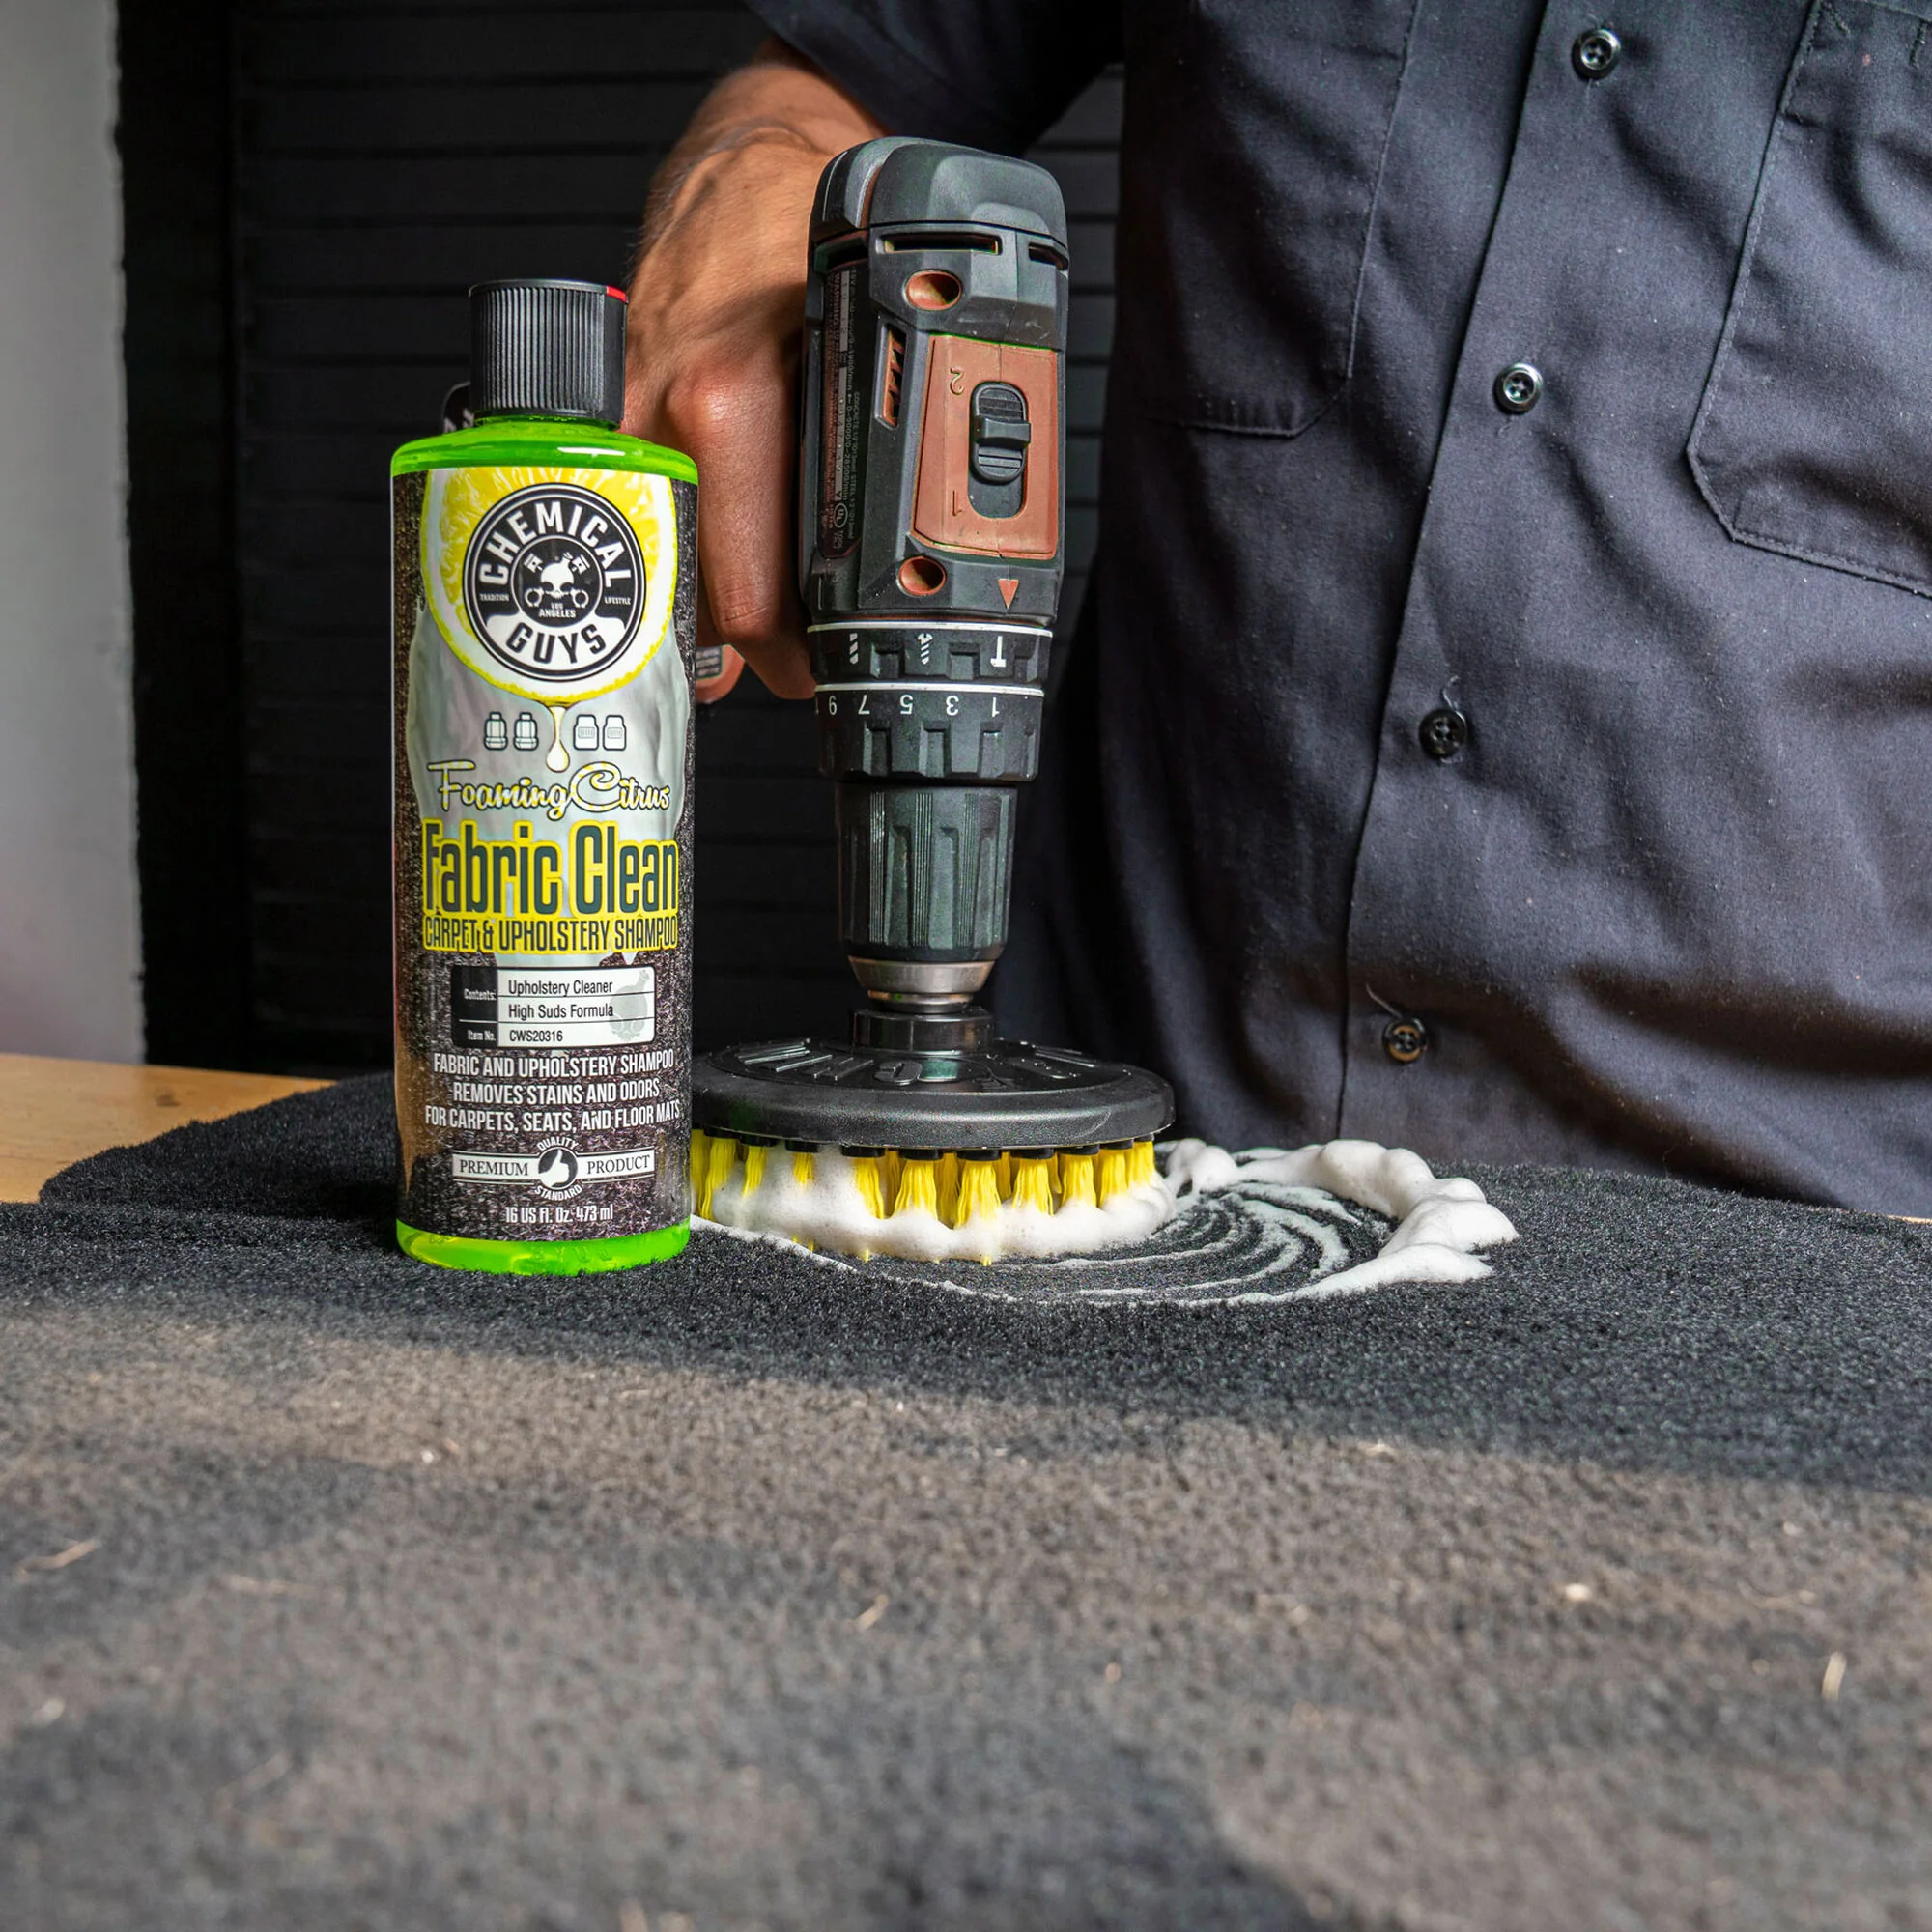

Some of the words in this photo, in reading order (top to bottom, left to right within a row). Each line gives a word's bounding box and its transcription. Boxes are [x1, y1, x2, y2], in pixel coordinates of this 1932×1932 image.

[950, 367, 964, 396] 2
[479, 501, 632, 588] CHEMICAL
[479, 593, 510, 603] TRADITION
[551, 602, 563, 611] LOS
[604, 595, 632, 606] LIFESTYLE
[538, 609, 577, 619] ANGELES
[506, 621, 606, 665] GUYS
[828, 695, 838, 715] 9
[857, 694, 870, 715] 7
[899, 694, 914, 715] 5
[945, 695, 959, 716] 3
[991, 696, 1000, 718] 1
[427, 759, 571, 821] Foaming
[569, 761, 671, 813] Citrus
[424, 821, 560, 916] Fabric
[573, 821, 677, 916] Clean
[425, 917, 478, 949] CARPET
[482, 919, 494, 950] &
[498, 918, 610, 951] UPHOLSTERY
[614, 916, 677, 950] SHAMPOO
[463, 988, 497, 1001] Contents:
[508, 980, 570, 996] Upholstery
[573, 980, 613, 994] Cleaner
[508, 1004, 535, 1022] High
[538, 1004, 567, 1019] Suds
[570, 1003, 614, 1018] Formula
[467, 1030, 484, 1041] Item
[484, 1030, 497, 1041] No.
[509, 1030, 563, 1043] CWS20316
[434, 1053, 480, 1076] FABRIC
[483, 1059, 515, 1077] AND
[518, 1055, 616, 1078] UPHOLSTERY
[620, 1049, 674, 1074] SHAMPOO
[452, 1082, 523, 1105] REMOVES
[526, 1084, 584, 1105] STAINS
[586, 1082, 617, 1103] AND
[620, 1078, 660, 1101] ODORS
[425, 1105, 447, 1127] FOR
[449, 1108, 519, 1133] CARPETS,
[524, 1111, 578, 1133] SEATS,
[581, 1110, 612, 1130] AND
[614, 1106, 655, 1127] FLOOR
[656, 1099, 680, 1121] MATS
[537, 1136, 579, 1151] QUALITY
[459, 1159, 529, 1176] PREMIUM
[586, 1154, 651, 1175] PRODUCT
[534, 1184, 583, 1201] STANDARD
[505, 1207, 518, 1223] 16
[521, 1207, 537, 1223] US
[576, 1205, 598, 1221] 473
[600, 1204, 613, 1220] ml
